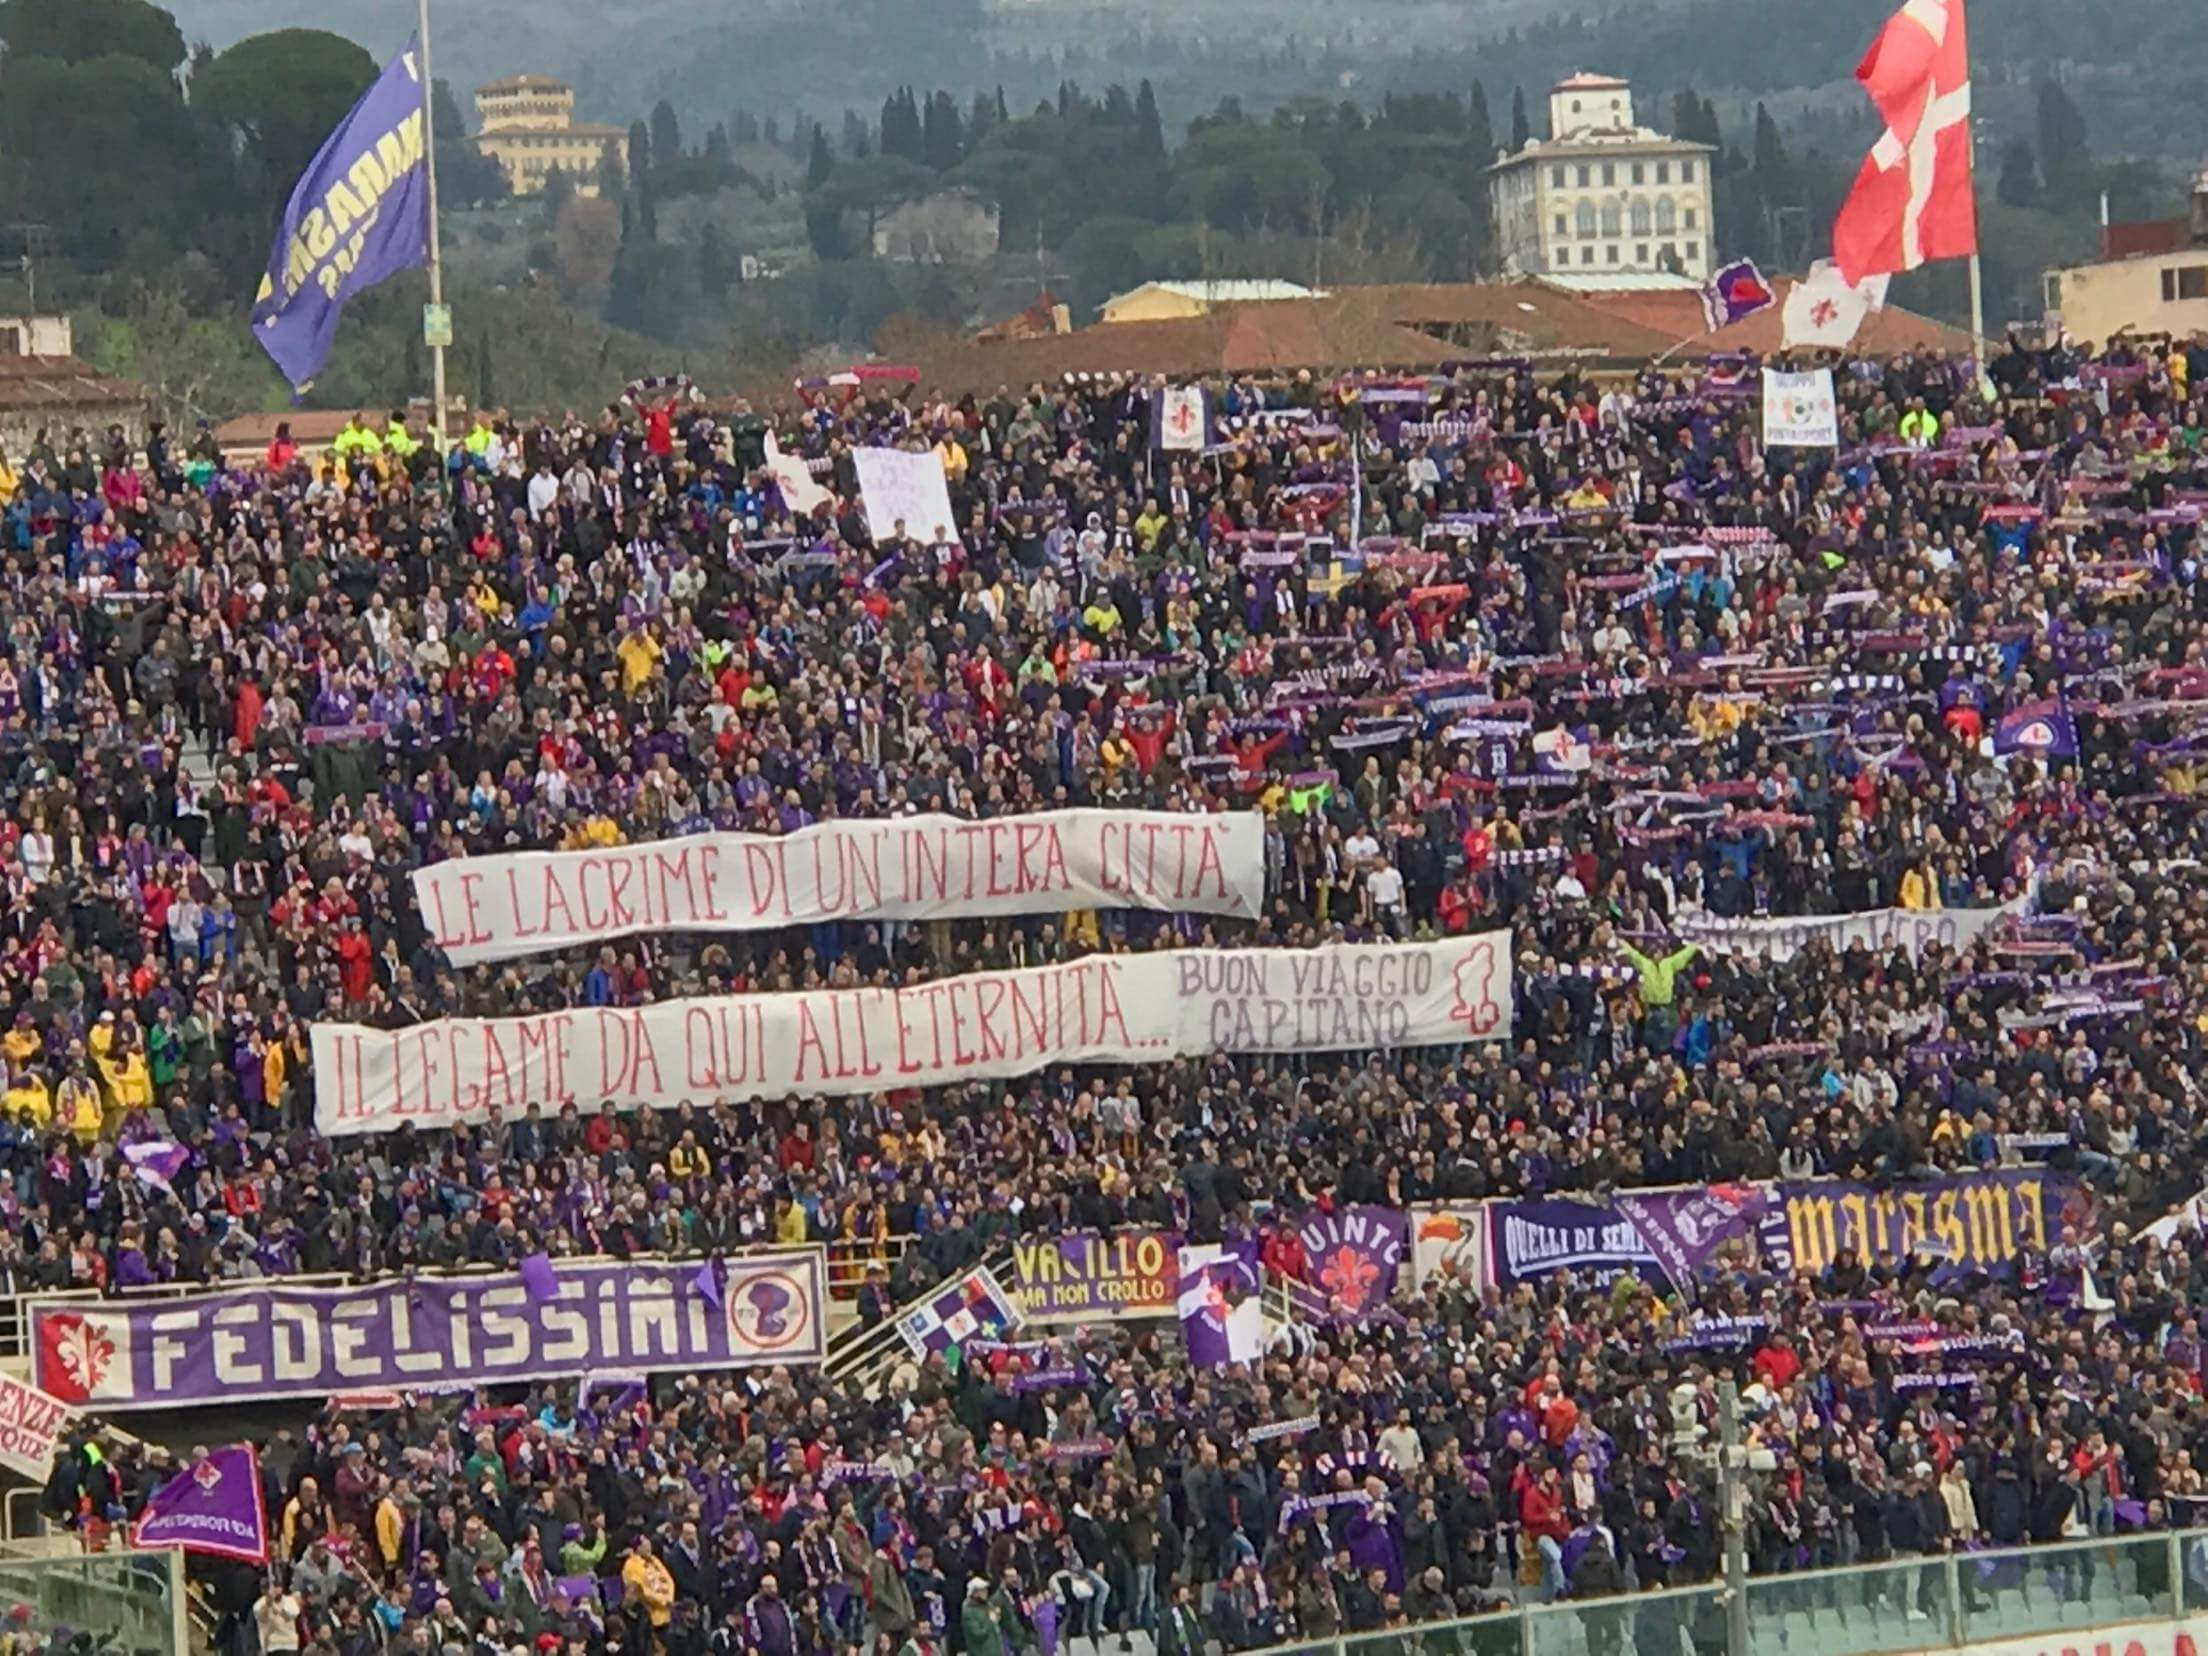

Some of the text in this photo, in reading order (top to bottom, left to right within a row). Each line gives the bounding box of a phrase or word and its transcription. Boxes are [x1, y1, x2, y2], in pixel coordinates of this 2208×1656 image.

[430, 872, 494, 948] LE
[507, 845, 727, 937] LACRIME
[743, 841, 793, 916] DI
[812, 822, 1072, 913] UN'INTERA
[1177, 951, 1433, 997] BUON VIAGGIO
[1209, 997, 1412, 1049] CAPITANO
[334, 1034, 375, 1119] IL
[390, 1015, 576, 1115] LEGAME
[598, 1007, 663, 1097] DA
[685, 1002, 766, 1090] QUI
[1505, 1215, 1569, 1263] QUELLI
[1575, 1226, 1596, 1252] DI
[1053, 1282, 1090, 1305] NON
[1096, 1279, 1165, 1301] CROLLO
